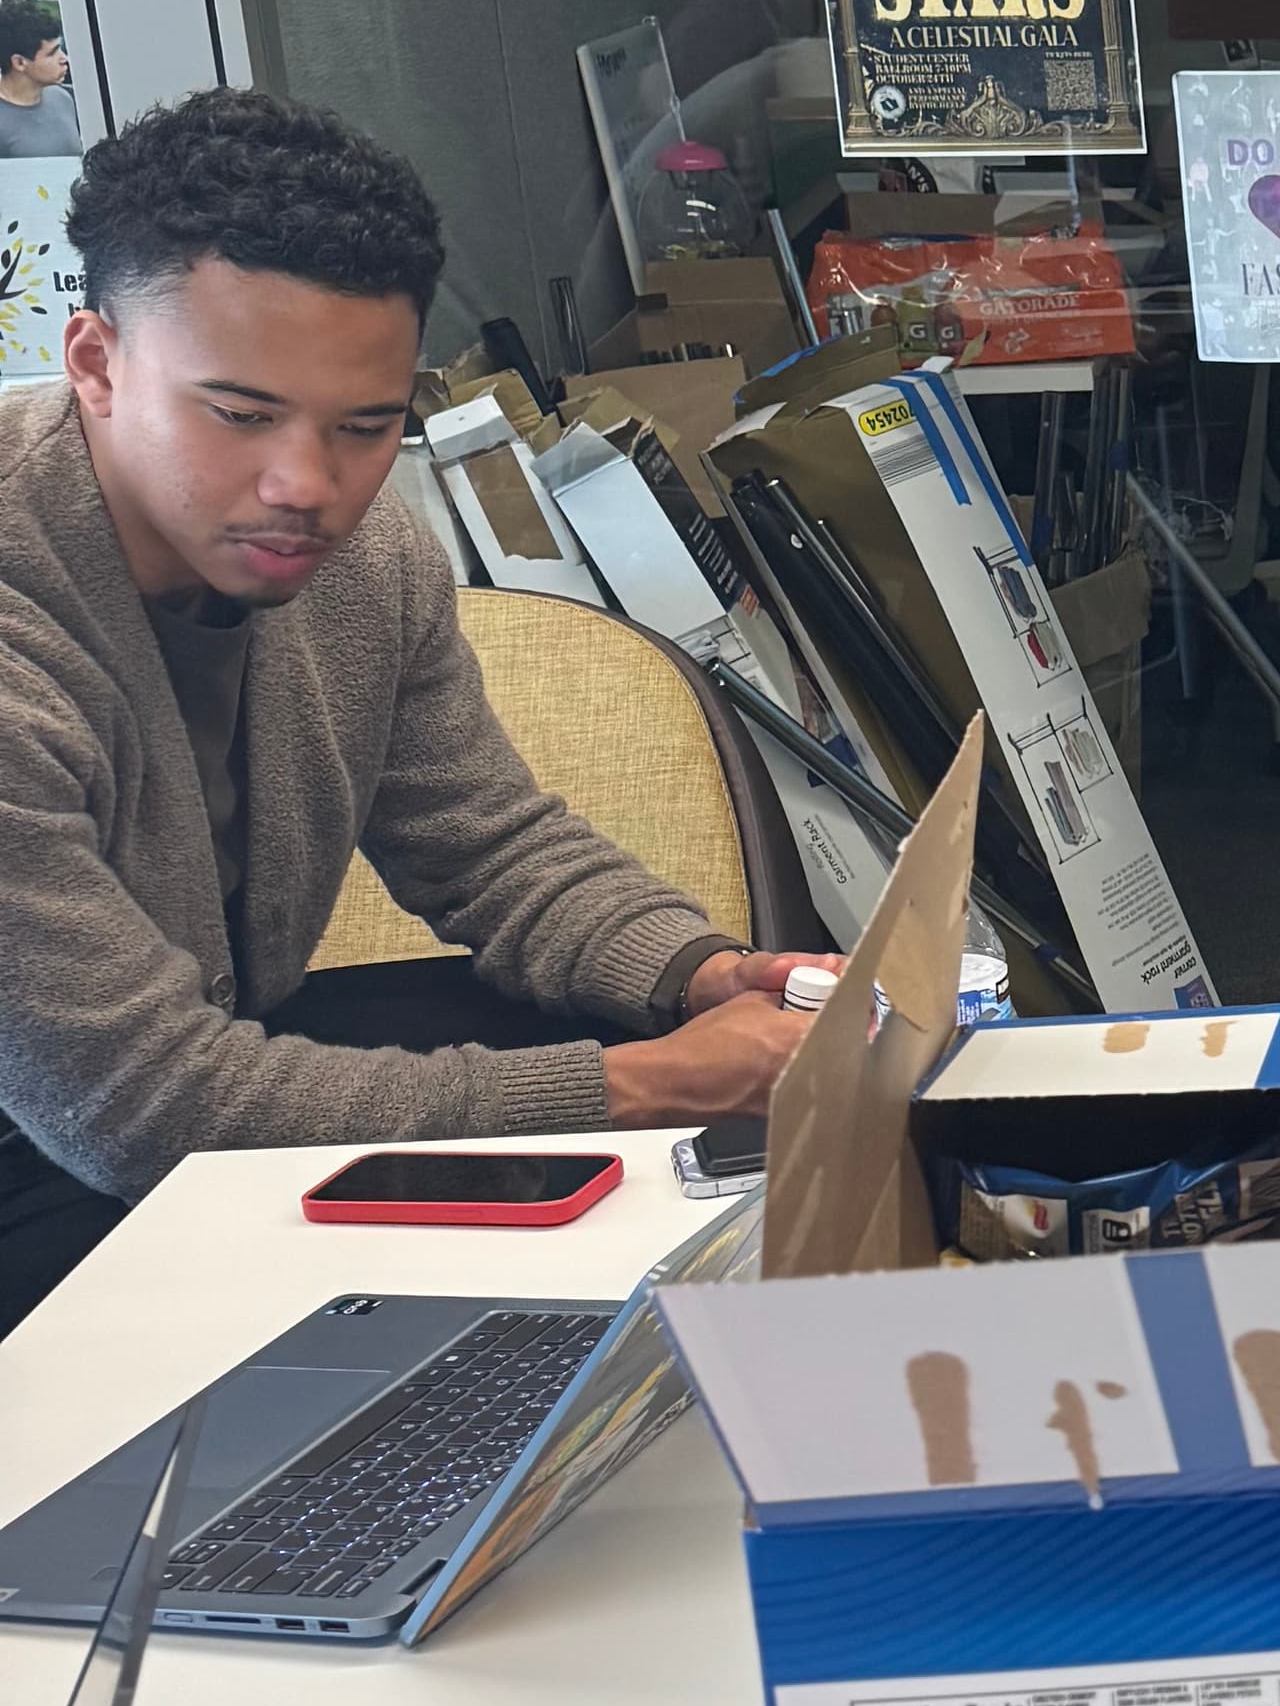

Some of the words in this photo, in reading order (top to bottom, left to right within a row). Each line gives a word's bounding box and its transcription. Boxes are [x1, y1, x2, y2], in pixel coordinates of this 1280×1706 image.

[890, 27, 906, 48] A
[907, 25, 1019, 48] CELESTIAL
[1020, 24, 1079, 47] GALA
[874, 54, 923, 64] STUDENT
[924, 53, 969, 63] CENTER
[875, 64, 934, 73] BALLROOM
[875, 75, 925, 84] OCTOBER
[1227, 138, 1275, 166] DO
[980, 294, 1080, 316] GATORADE
[910, 323, 927, 339] G
[940, 325, 955, 340] G
[802, 818, 821, 842] Rack
[818, 841, 847, 884] Garment
